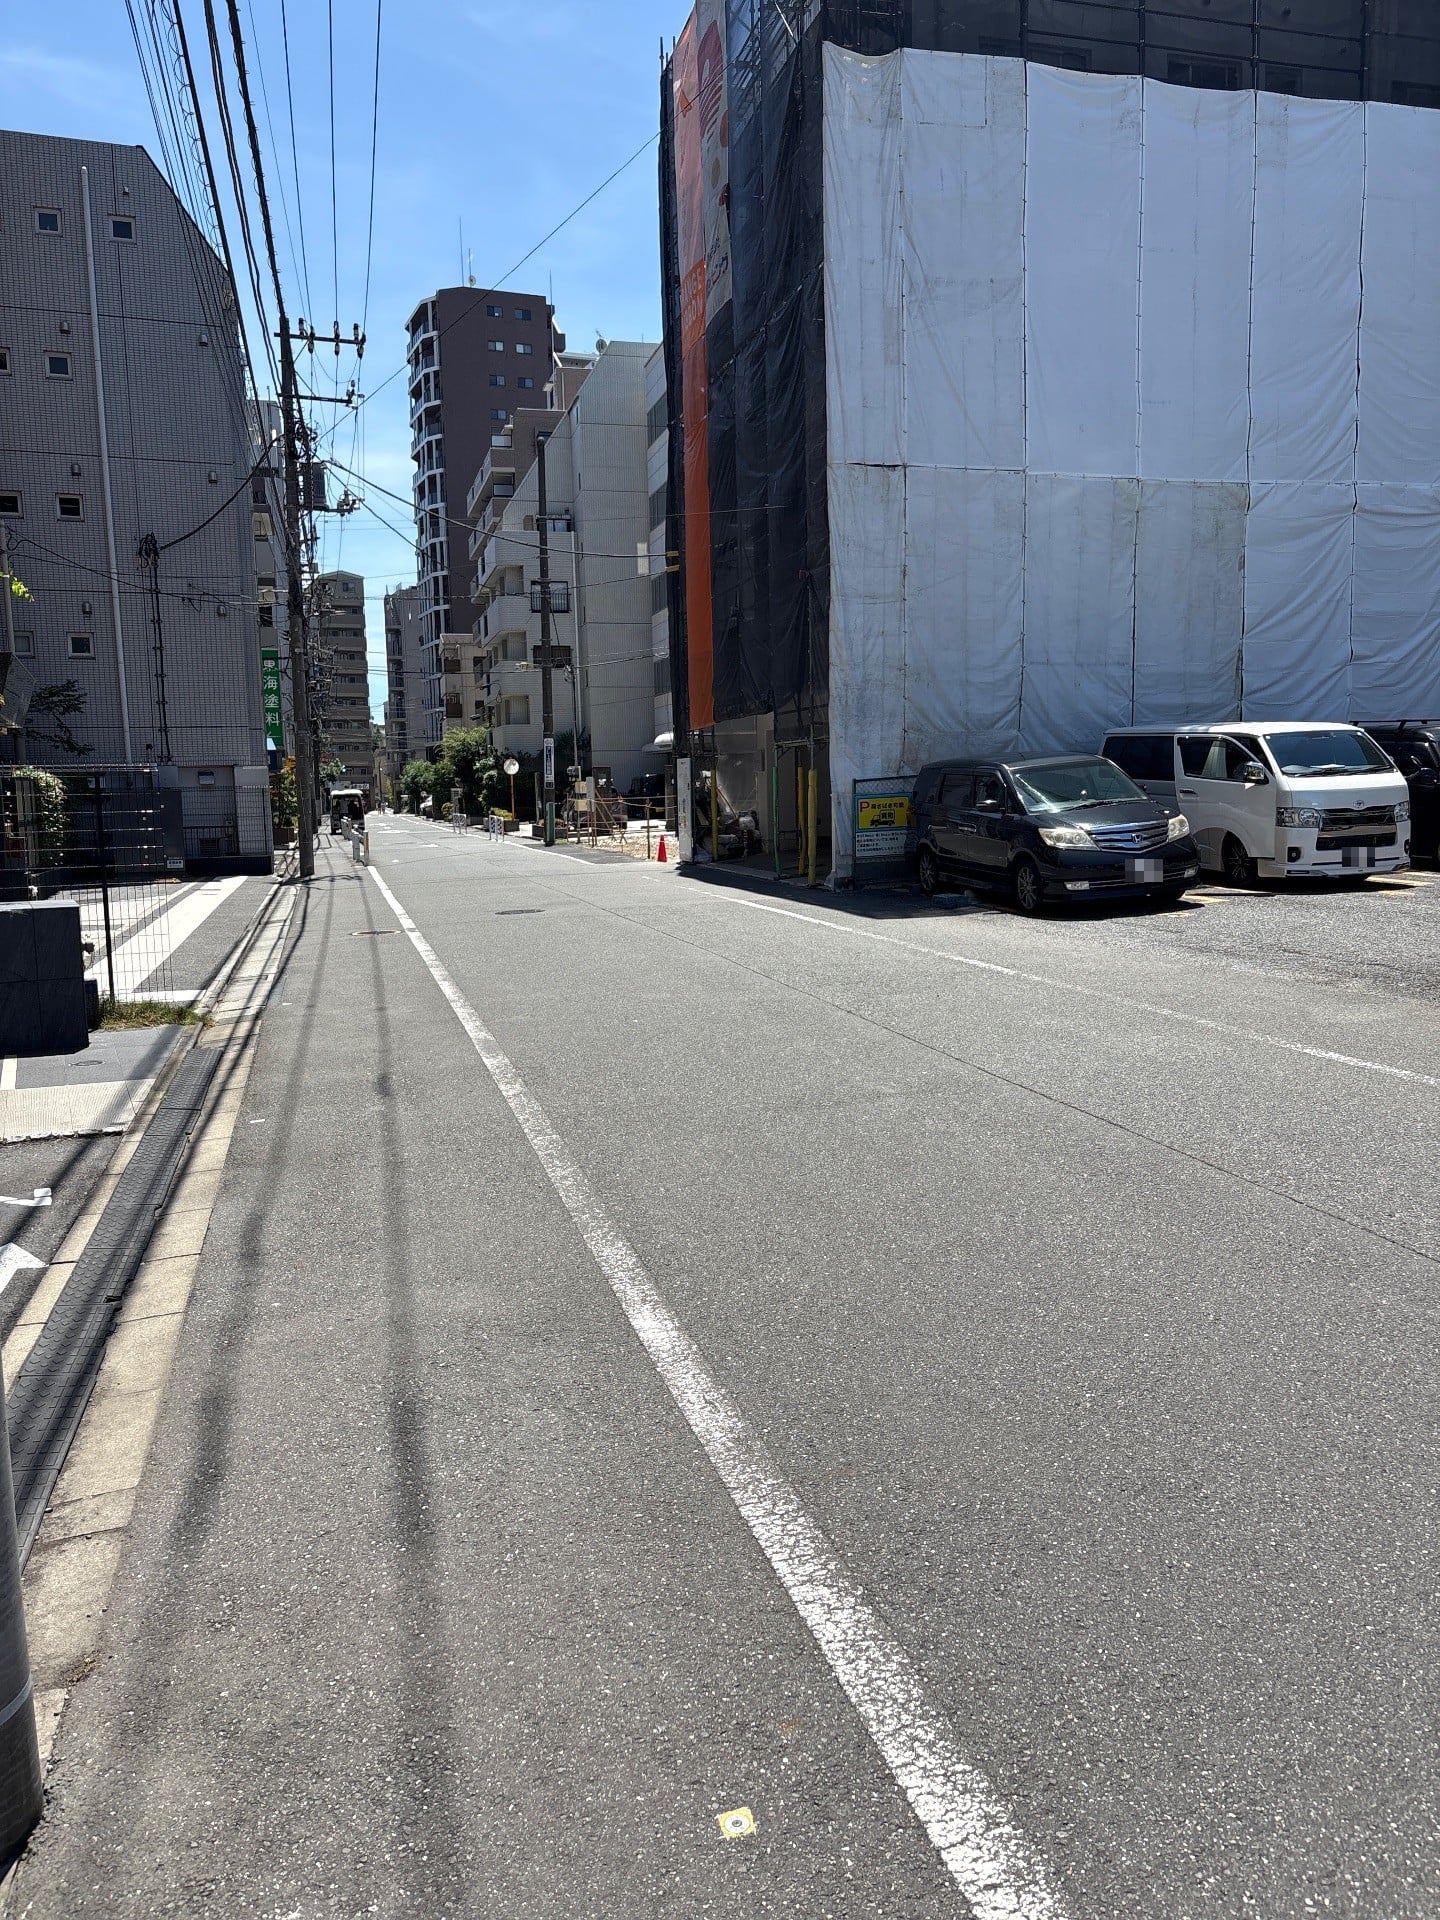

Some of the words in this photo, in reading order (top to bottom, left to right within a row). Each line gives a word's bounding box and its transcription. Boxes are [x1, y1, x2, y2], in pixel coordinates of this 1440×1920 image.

[262, 659, 280, 727] 東海塗料
[860, 801, 869, 812] P
